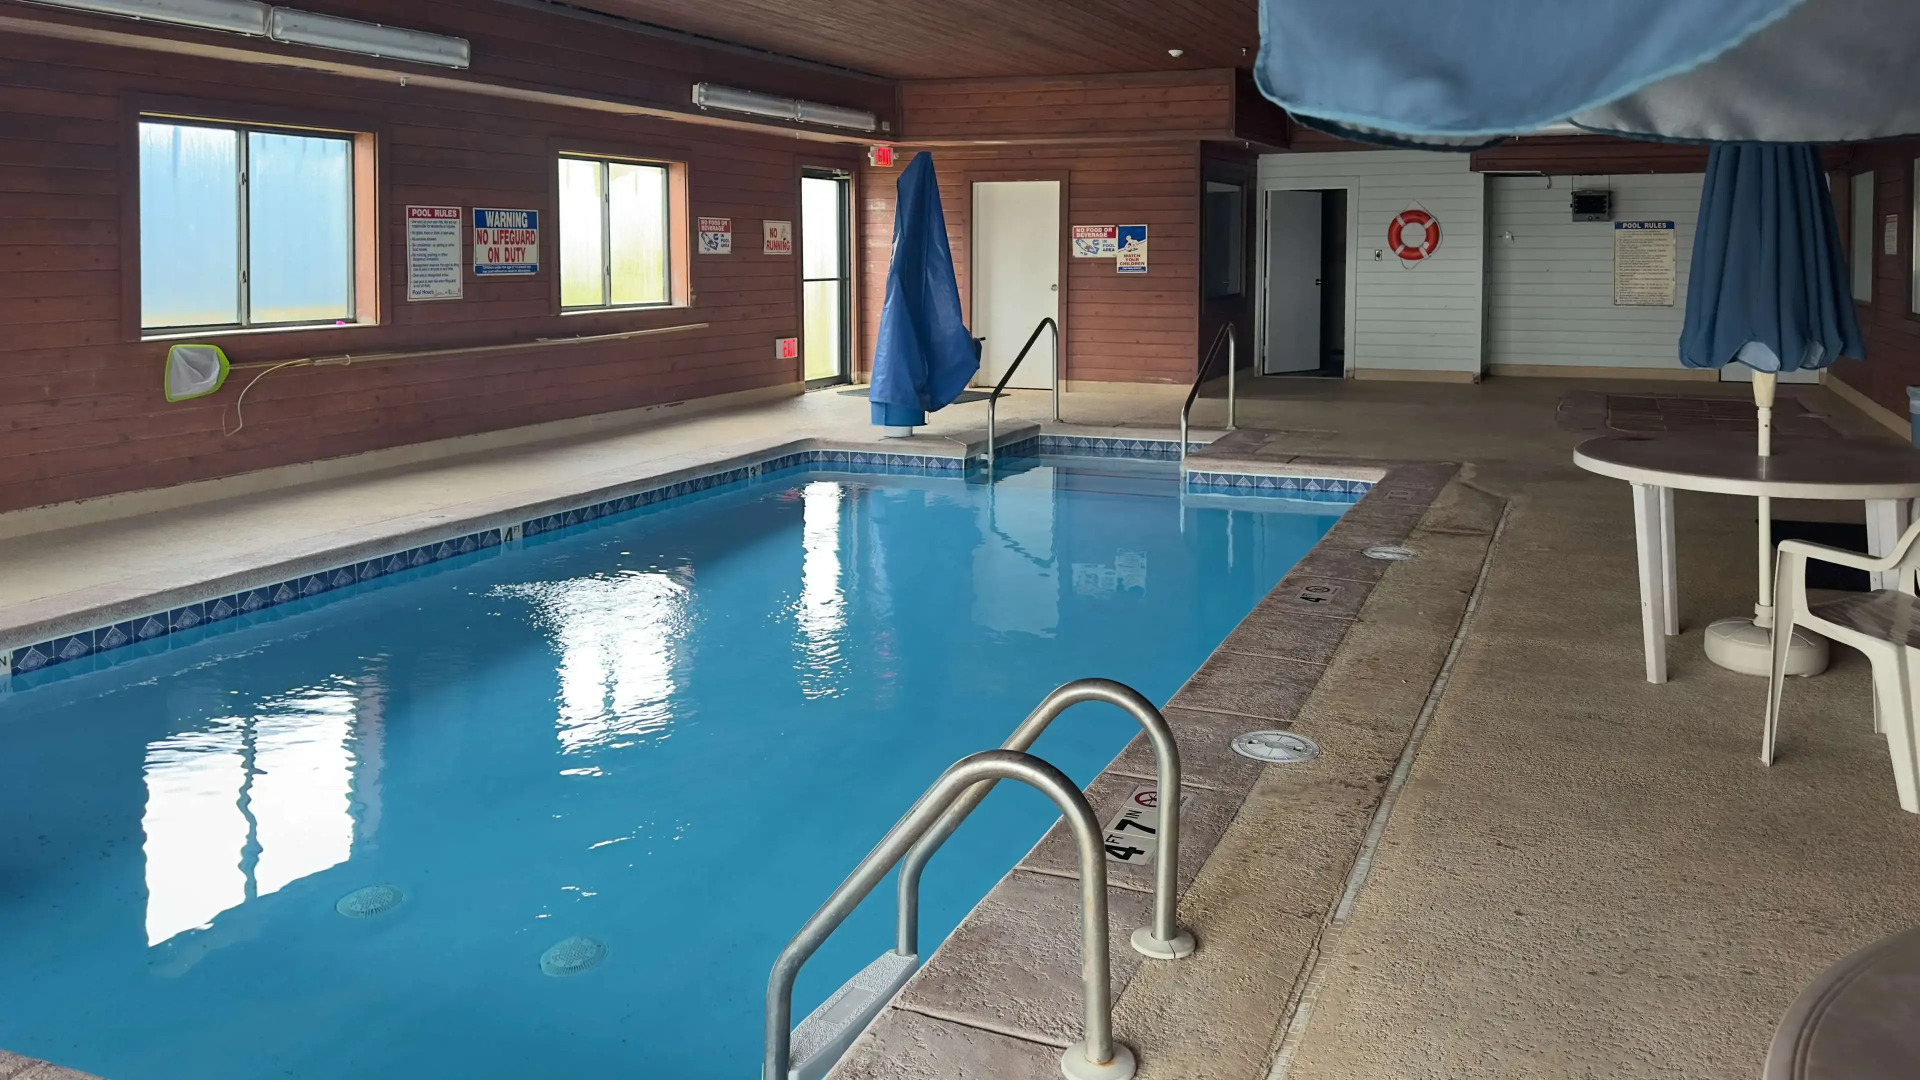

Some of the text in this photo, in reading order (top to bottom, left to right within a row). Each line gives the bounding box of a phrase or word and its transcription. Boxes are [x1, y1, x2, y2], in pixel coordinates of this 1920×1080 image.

[411, 208, 457, 218] POOL RULES
[485, 211, 528, 228] WARNING
[476, 229, 536, 245] NO LIFEGUARD
[769, 228, 778, 238] NO
[766, 240, 790, 251] RUNNING
[488, 247, 526, 263] ON DUTY
[514, 525, 520, 533] FT
[1105, 809, 1156, 861] 4 FT 7 IN
